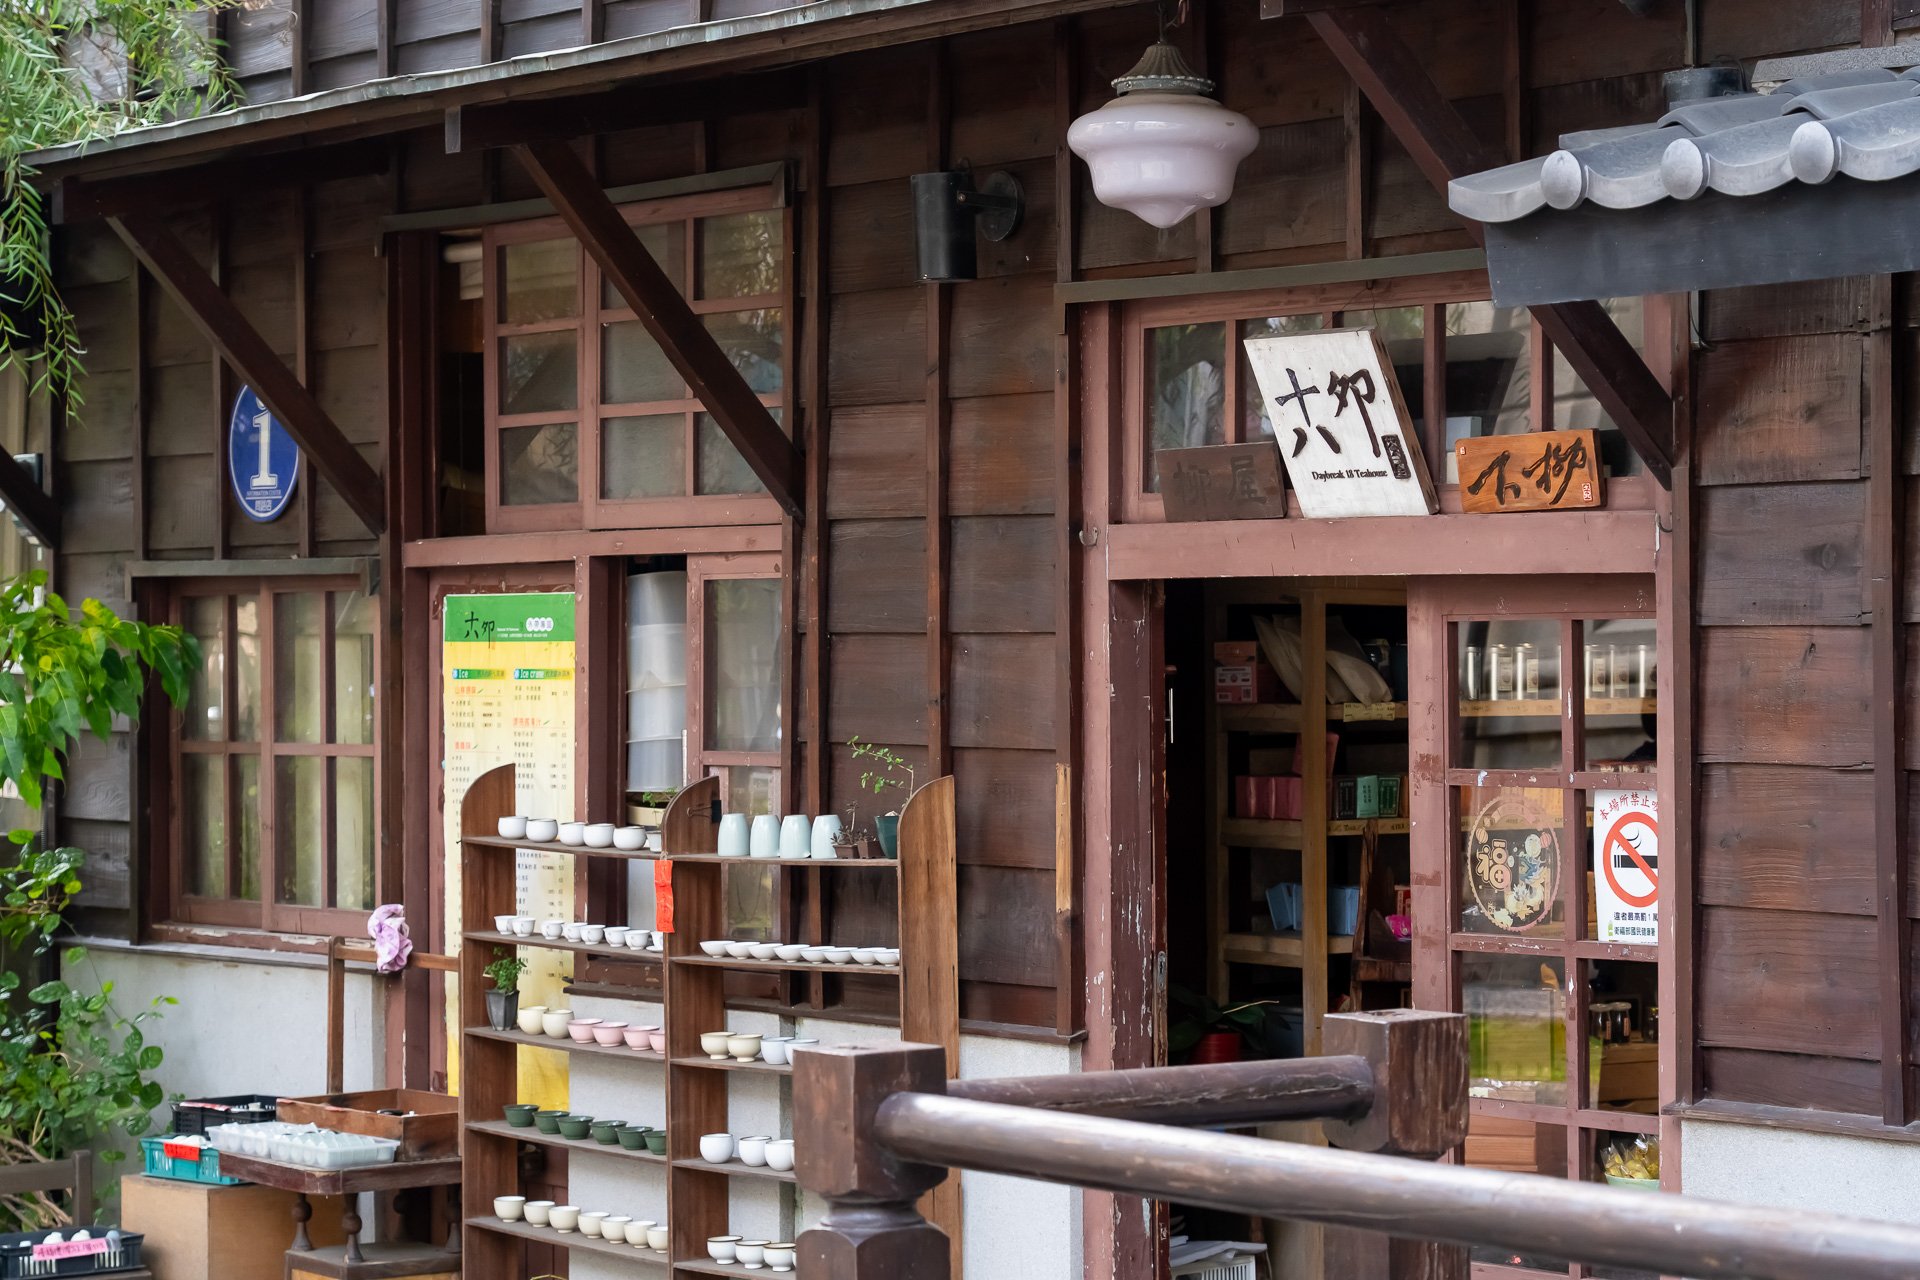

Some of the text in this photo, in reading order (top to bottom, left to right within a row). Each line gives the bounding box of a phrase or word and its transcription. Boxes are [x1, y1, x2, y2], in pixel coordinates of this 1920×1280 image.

[1311, 469, 1388, 482] Daybreak 18 Teahouse
[1476, 838, 1512, 891] 福
